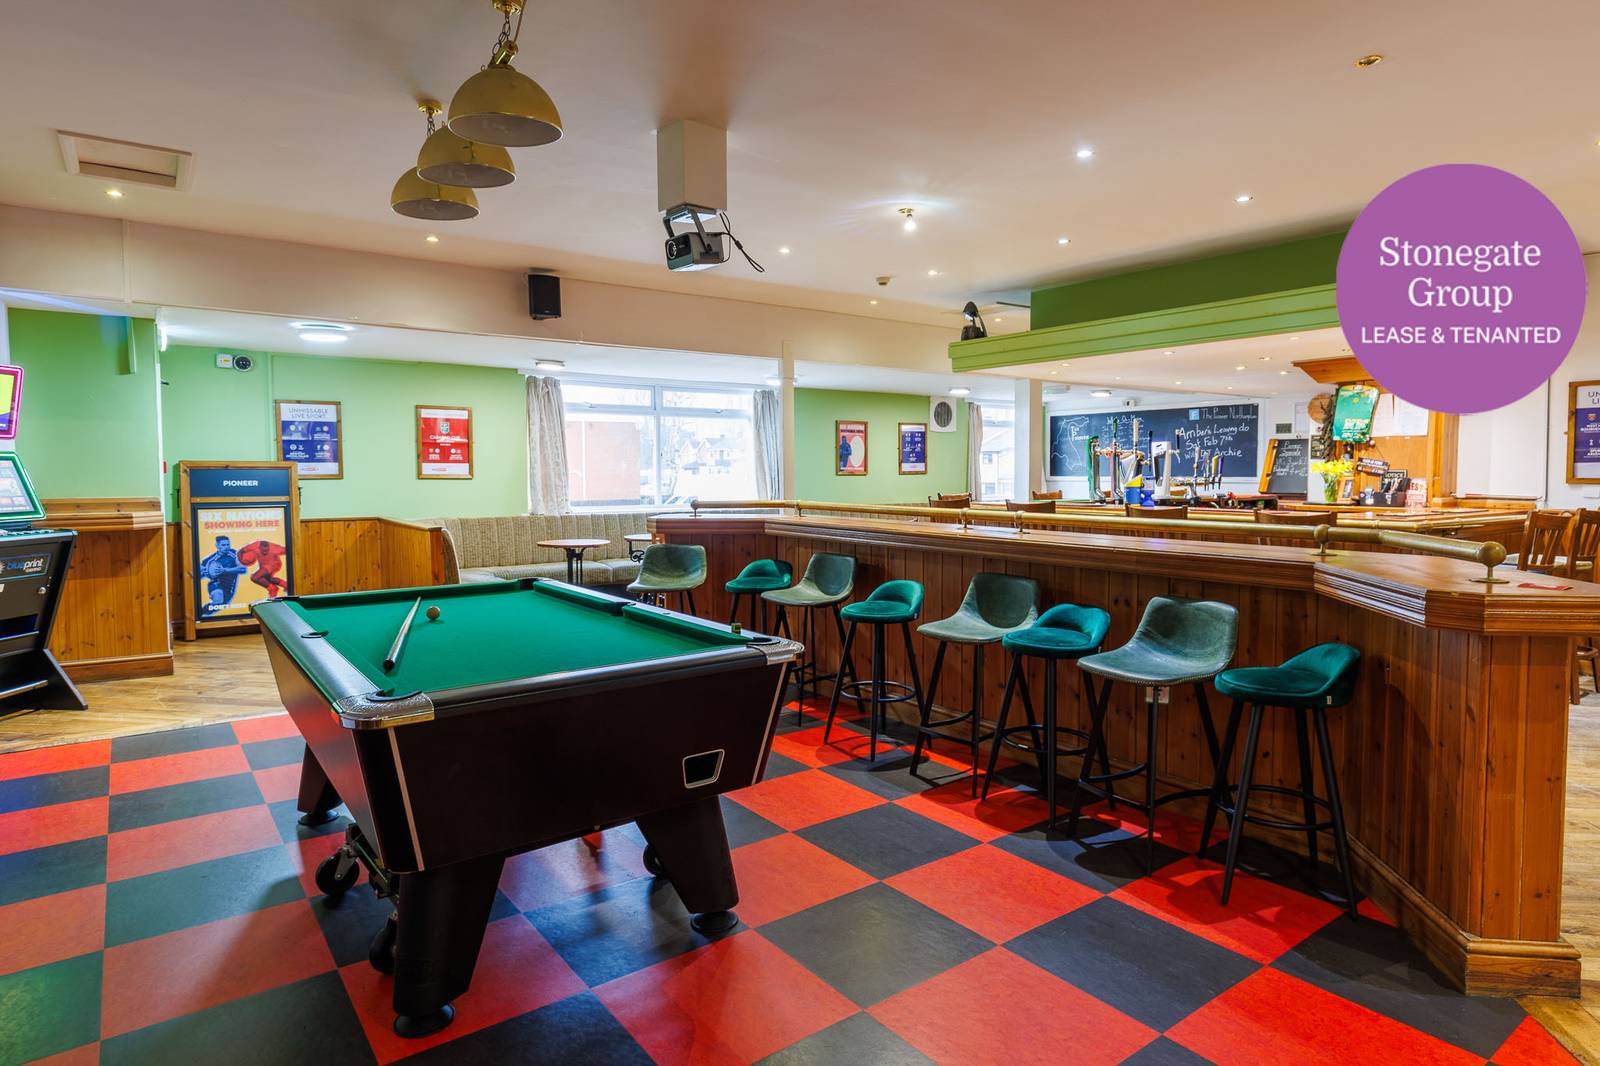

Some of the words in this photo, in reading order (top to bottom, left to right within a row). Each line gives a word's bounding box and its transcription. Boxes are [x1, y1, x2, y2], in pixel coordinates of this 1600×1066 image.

[1201, 407, 1212, 419] The
[1180, 424, 1212, 440] Amber's
[1214, 424, 1238, 435] Leaving
[1239, 423, 1250, 432] do
[1185, 440, 1201, 451] Sat
[1203, 436, 1218, 446] Feb
[1214, 447, 1243, 457] Archie
[204, 521, 253, 529] SHOWING
[255, 520, 280, 528] HERE
